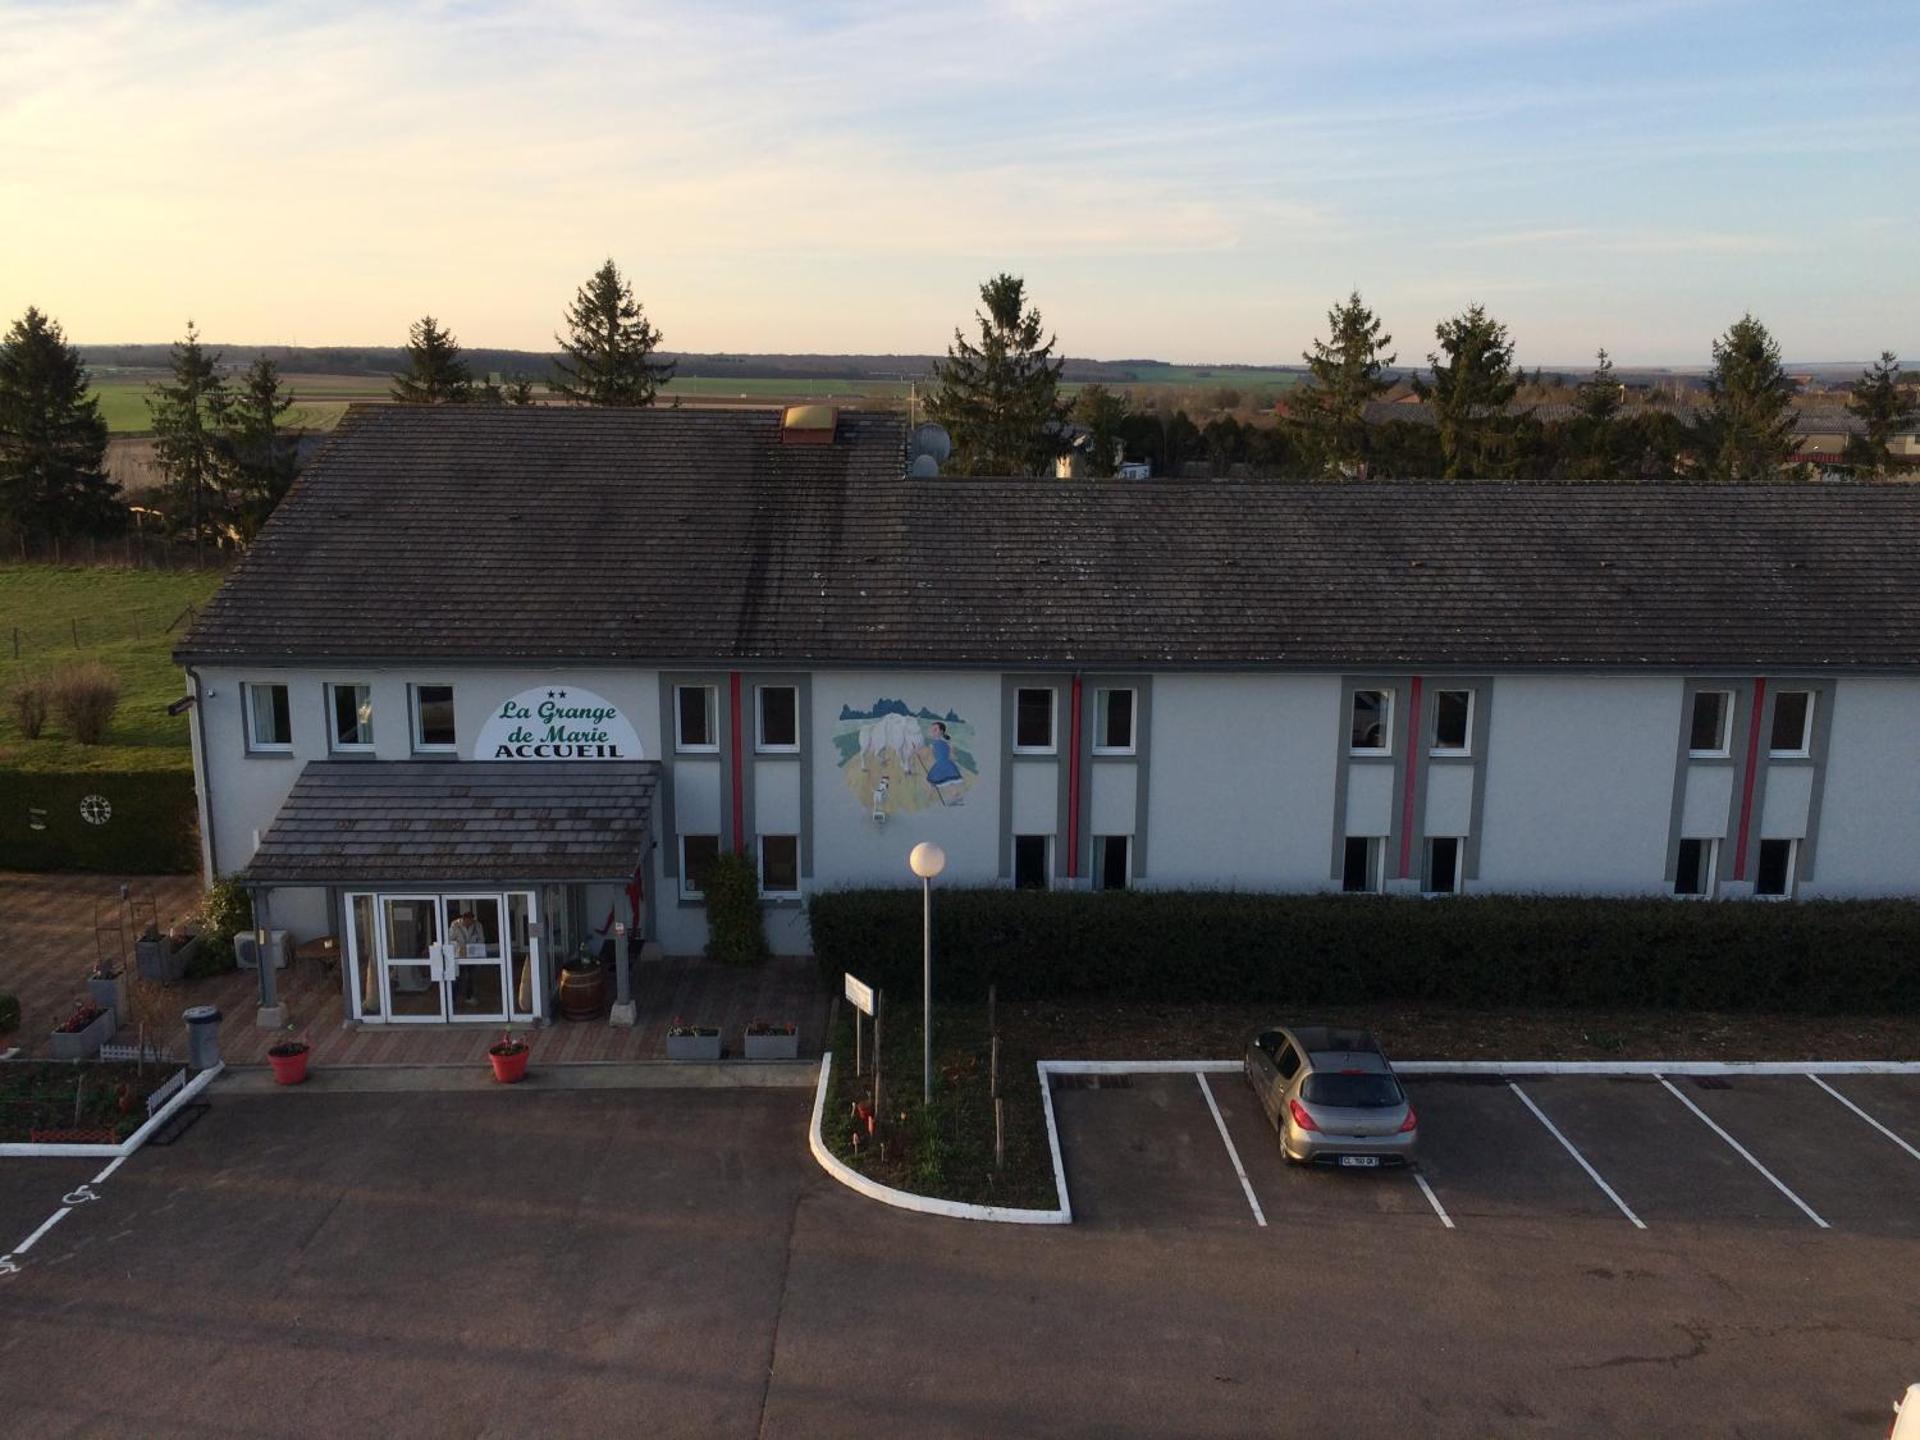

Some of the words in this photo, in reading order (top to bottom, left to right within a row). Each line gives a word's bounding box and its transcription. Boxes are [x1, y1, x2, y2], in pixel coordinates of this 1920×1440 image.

[499, 701, 531, 719] La
[538, 701, 616, 724] Grange
[508, 726, 533, 743] de
[540, 725, 609, 743] Marie
[494, 745, 624, 758] ACCUEIL
